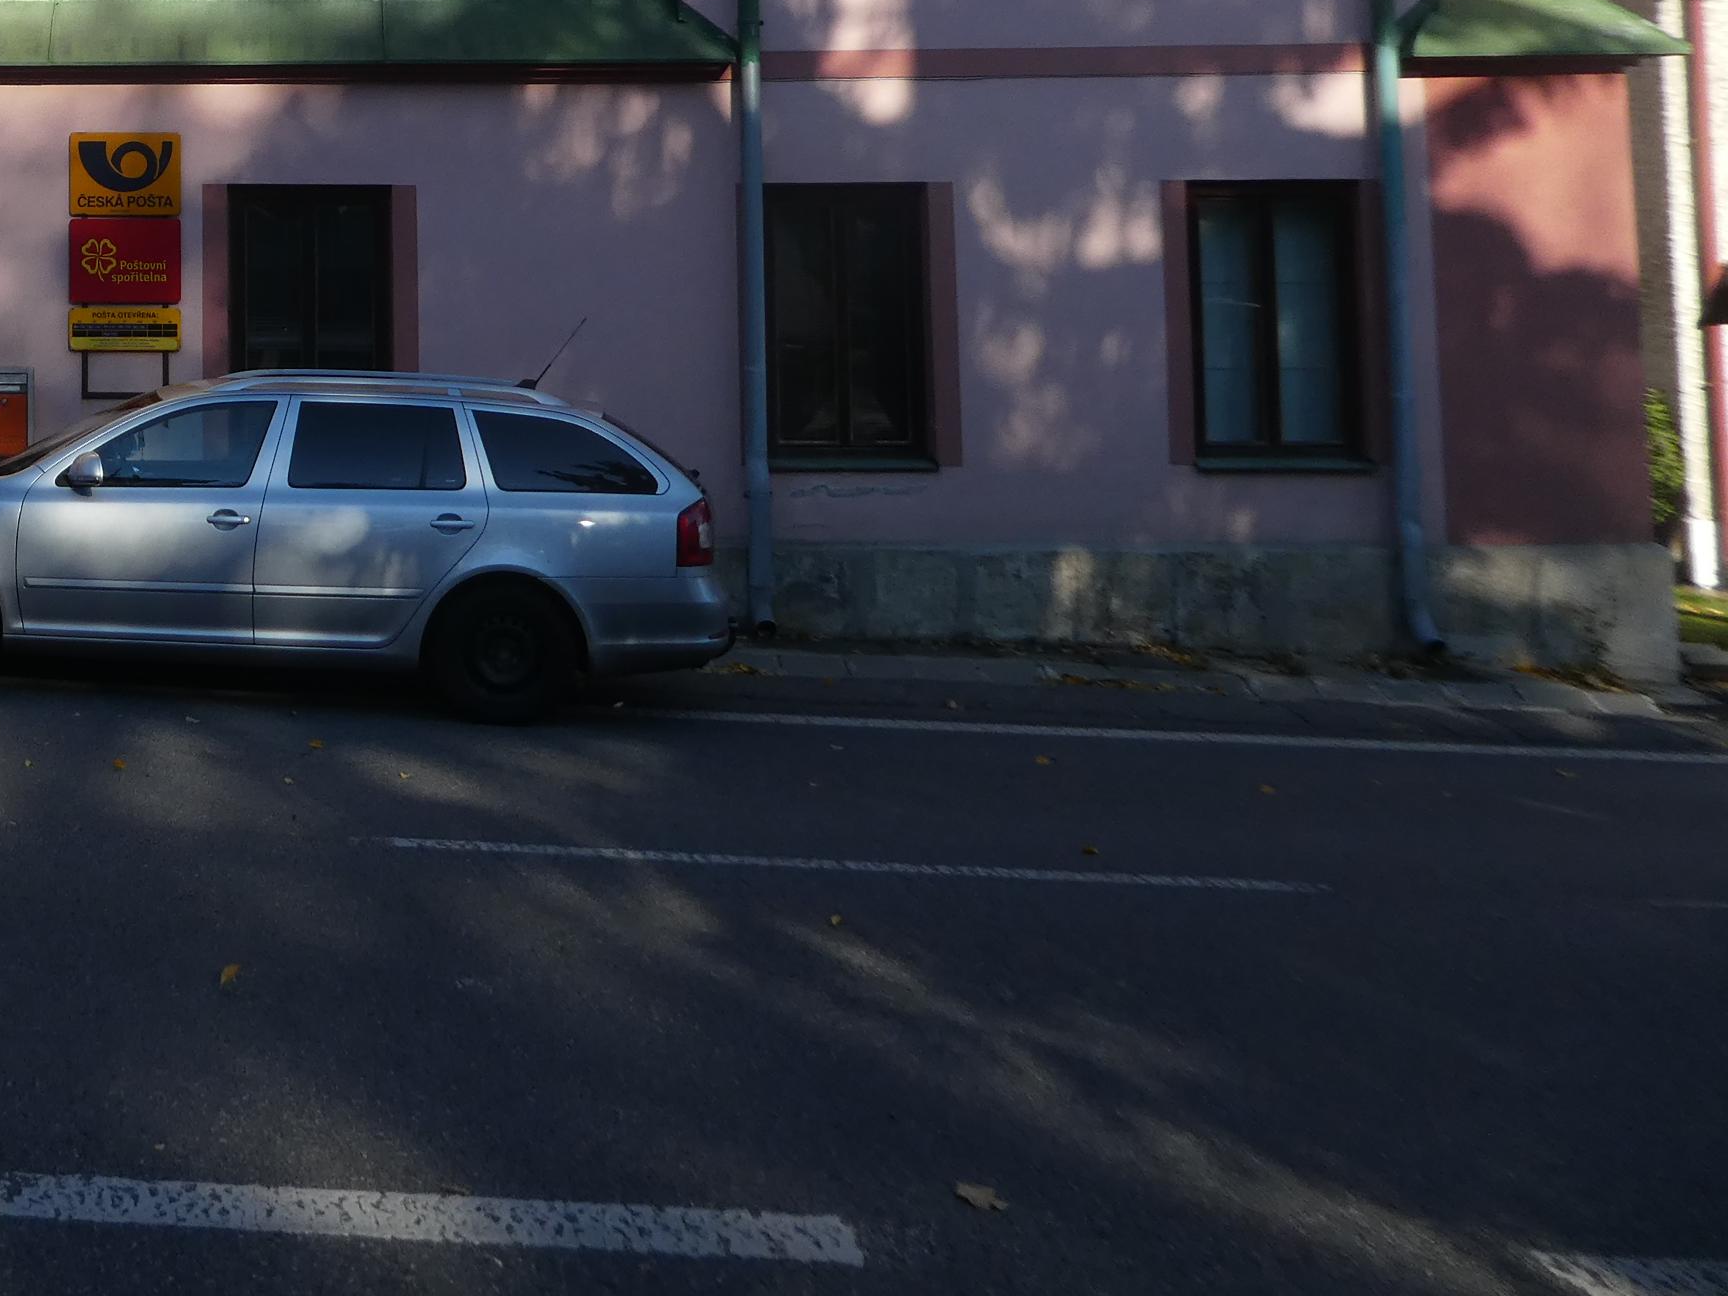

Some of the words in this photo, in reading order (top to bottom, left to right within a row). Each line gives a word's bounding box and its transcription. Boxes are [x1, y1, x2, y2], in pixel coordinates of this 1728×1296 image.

[77, 193, 124, 208] ČESKÁ
[127, 193, 173, 208] POŠTA
[119, 258, 167, 271] Poštovní
[111, 271, 167, 285] spořitelna
[92, 310, 116, 319] POŠTA
